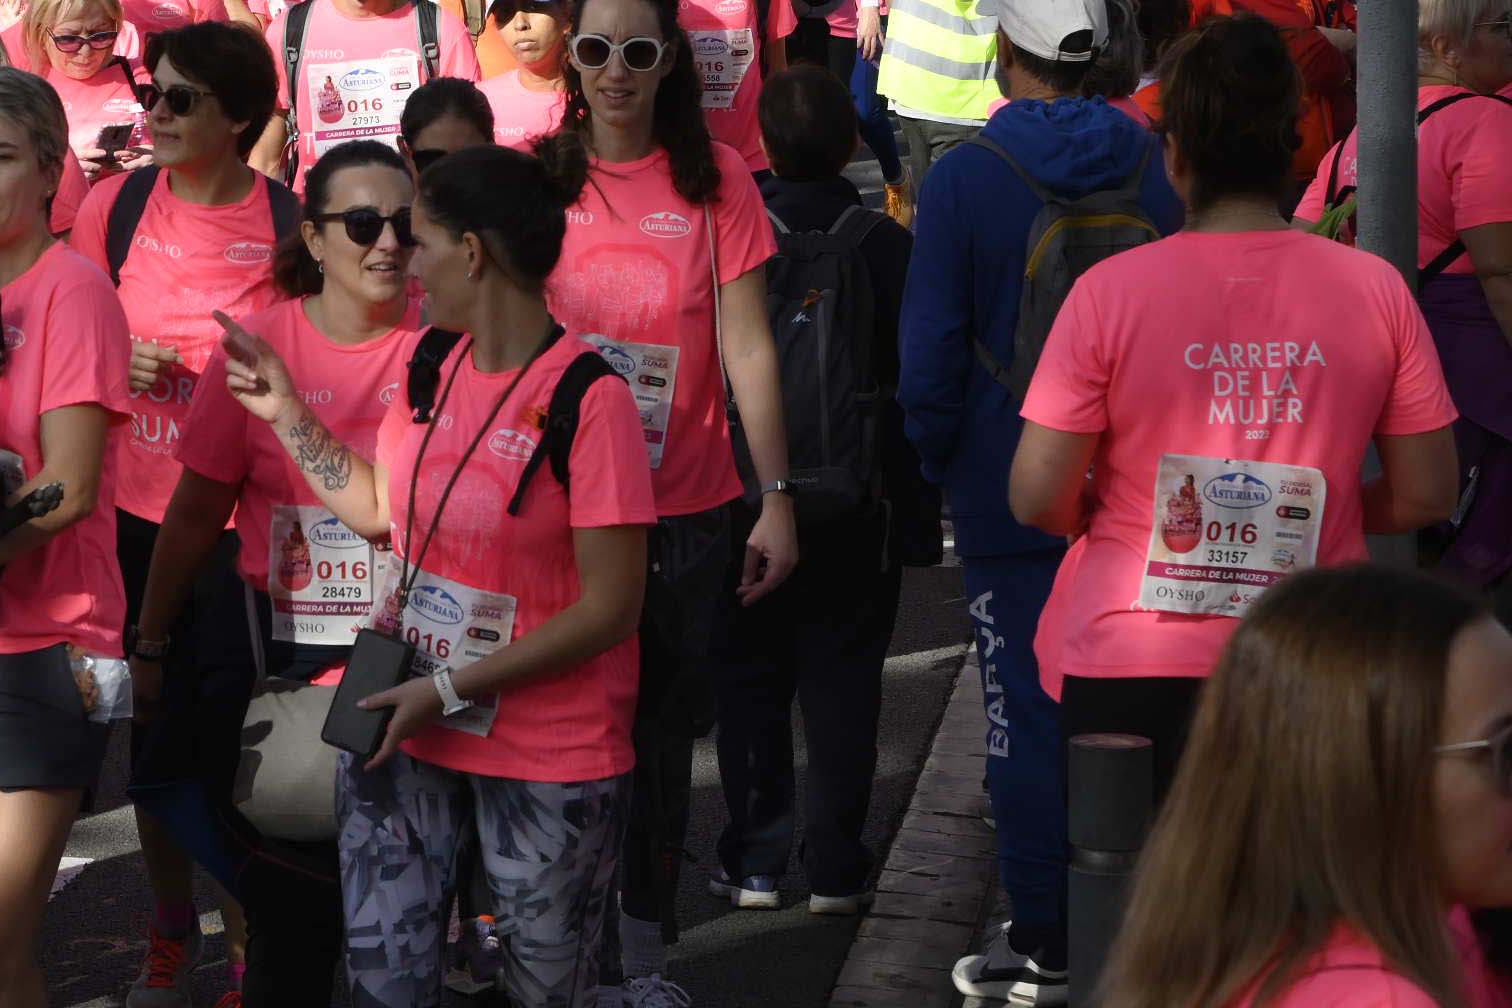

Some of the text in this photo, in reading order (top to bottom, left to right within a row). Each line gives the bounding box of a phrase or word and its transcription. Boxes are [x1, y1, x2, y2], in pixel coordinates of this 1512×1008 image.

[346, 97, 383, 113] 016
[351, 114, 381, 126] 27973
[325, 129, 355, 139] CARRERA
[356, 128, 365, 136] DE
[374, 126, 396, 135] MUJER
[643, 220, 689, 233] ASTURIANA
[1183, 341, 1327, 371] CARRERA
[1213, 370, 1299, 398] DE LA
[1208, 398, 1304, 426] MUJER
[1209, 483, 1312, 503] ASTURIANA SUMA
[1206, 520, 1259, 545] 016
[1207, 549, 1249, 564] 33157
[316, 560, 368, 581] 016
[1165, 567, 1208, 579] CARRERA
[1208, 569, 1222, 580] DE
[1223, 571, 1236, 581] LA
[1237, 572, 1270, 584] MUJER
[321, 586, 362, 599] 28479
[1156, 585, 1206, 602] OYSHO
[326, 604, 339, 613] DE
[339, 605, 351, 613] LA
[410, 594, 461, 621] ASTURIANA
[406, 625, 451, 660] 016
